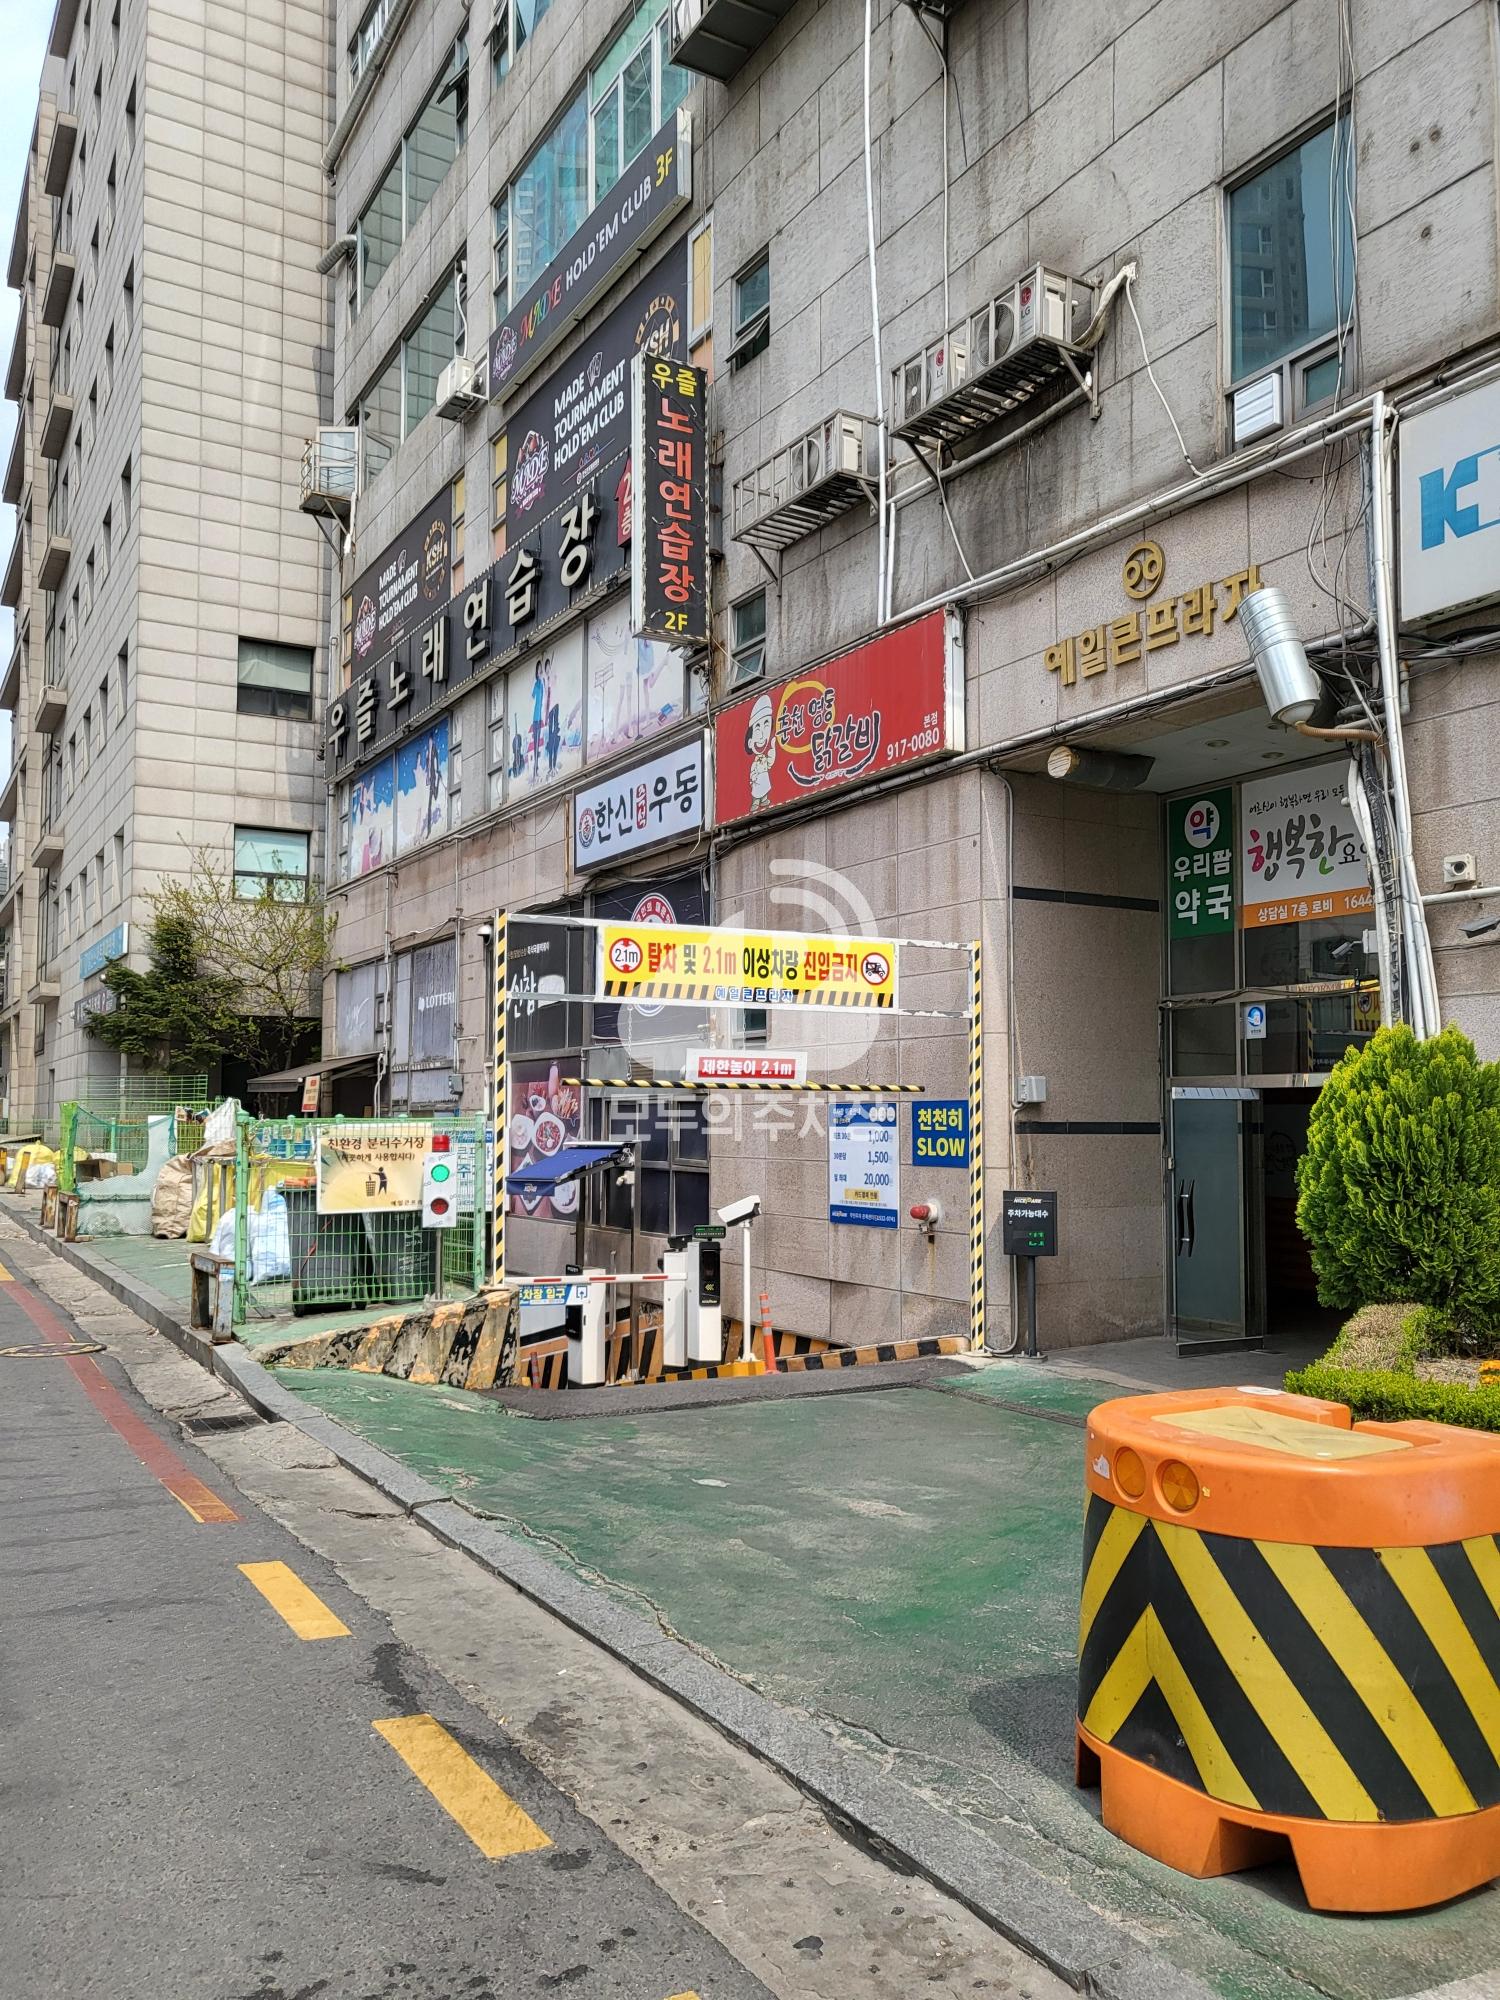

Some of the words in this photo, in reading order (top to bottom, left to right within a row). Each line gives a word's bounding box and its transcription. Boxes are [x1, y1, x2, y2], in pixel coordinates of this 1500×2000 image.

[565, 215, 619, 292] HOLD'EM
[621, 174, 652, 225] CLUB
[655, 147, 673, 187] 3F
[1021, 306, 1031, 319] LG
[554, 370, 585, 418] MADE
[651, 362, 698, 397] 우즐
[554, 359, 626, 444] TOURNAMENT
[553, 421, 599, 472] HOLD'EM
[600, 390, 625, 427] CLUB
[656, 397, 696, 603] 노래연습장
[378, 561, 397, 591] MADE
[378, 560, 419, 610] TOURNAMENT
[378, 597, 403, 631] HOLD'EM
[403, 582, 418, 609] CLUB
[664, 611, 688, 632] 2F
[1044, 565, 1264, 686] 예일큰프라자
[887, 728, 940, 761] 917-0080
[595, 787, 634, 844] 한신
[650, 763, 699, 823] 우동
[1189, 806, 1215, 840] 약
[1247, 813, 1355, 882] 행복한
[1173, 848, 1232, 882] 우리팜
[1175, 884, 1232, 925] 약국
[1257, 903, 1288, 922] 상담실
[1291, 901, 1309, 917] 7층
[1312, 898, 1334, 914] 로비
[614, 948, 639, 964] 2.1m
[647, 942, 678, 974] 탑차
[683, 944, 697, 976] 및
[702, 945, 737, 976] 2.1m
[742, 946, 799, 981] 이상차량
[803, 951, 858, 983] 진입금지
[715, 986, 794, 1003] 예일큰프라자
[701, 1058, 756, 1076] 제한높이
[761, 1060, 793, 1076] 2.1m
[917, 1108, 963, 1132] 천천히
[328, 1137, 362, 1150] 친환경
[367, 1136, 425, 1150] 분리수거장
[868, 1151, 889, 1165] 1,500
[917, 1137, 965, 1157] SLOW
[864, 1172, 890, 1187] 20,000
[1008, 1209, 1049, 1218] 주차가능대수
[546, 1286, 566, 1300] 입구
